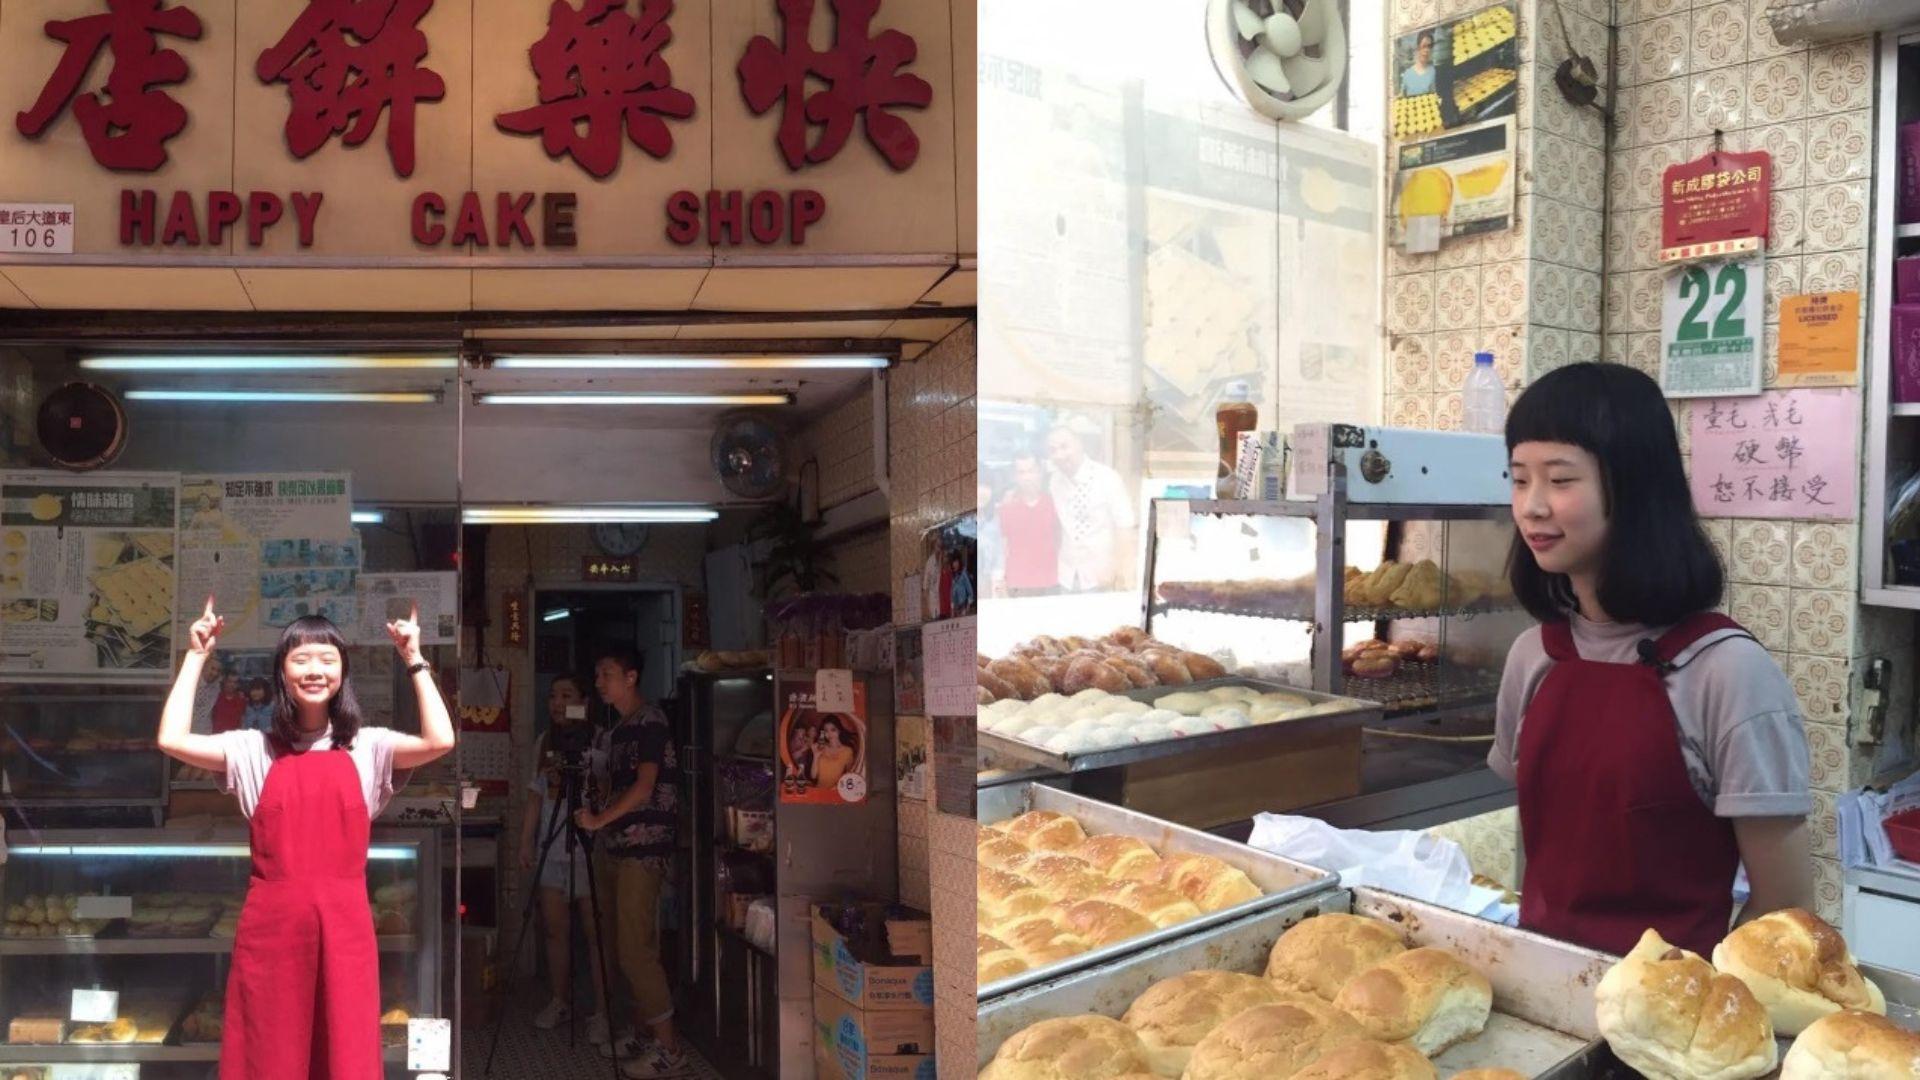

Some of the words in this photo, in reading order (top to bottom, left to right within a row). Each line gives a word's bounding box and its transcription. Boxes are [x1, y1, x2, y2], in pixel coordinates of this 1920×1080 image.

[11, 228, 55, 247] 106
[119, 190, 323, 247] HAPPY
[411, 191, 577, 248] CAKE
[665, 190, 826, 246] SHOP
[1677, 263, 1747, 341] 22
[1709, 473, 1836, 505] 恕不接受
